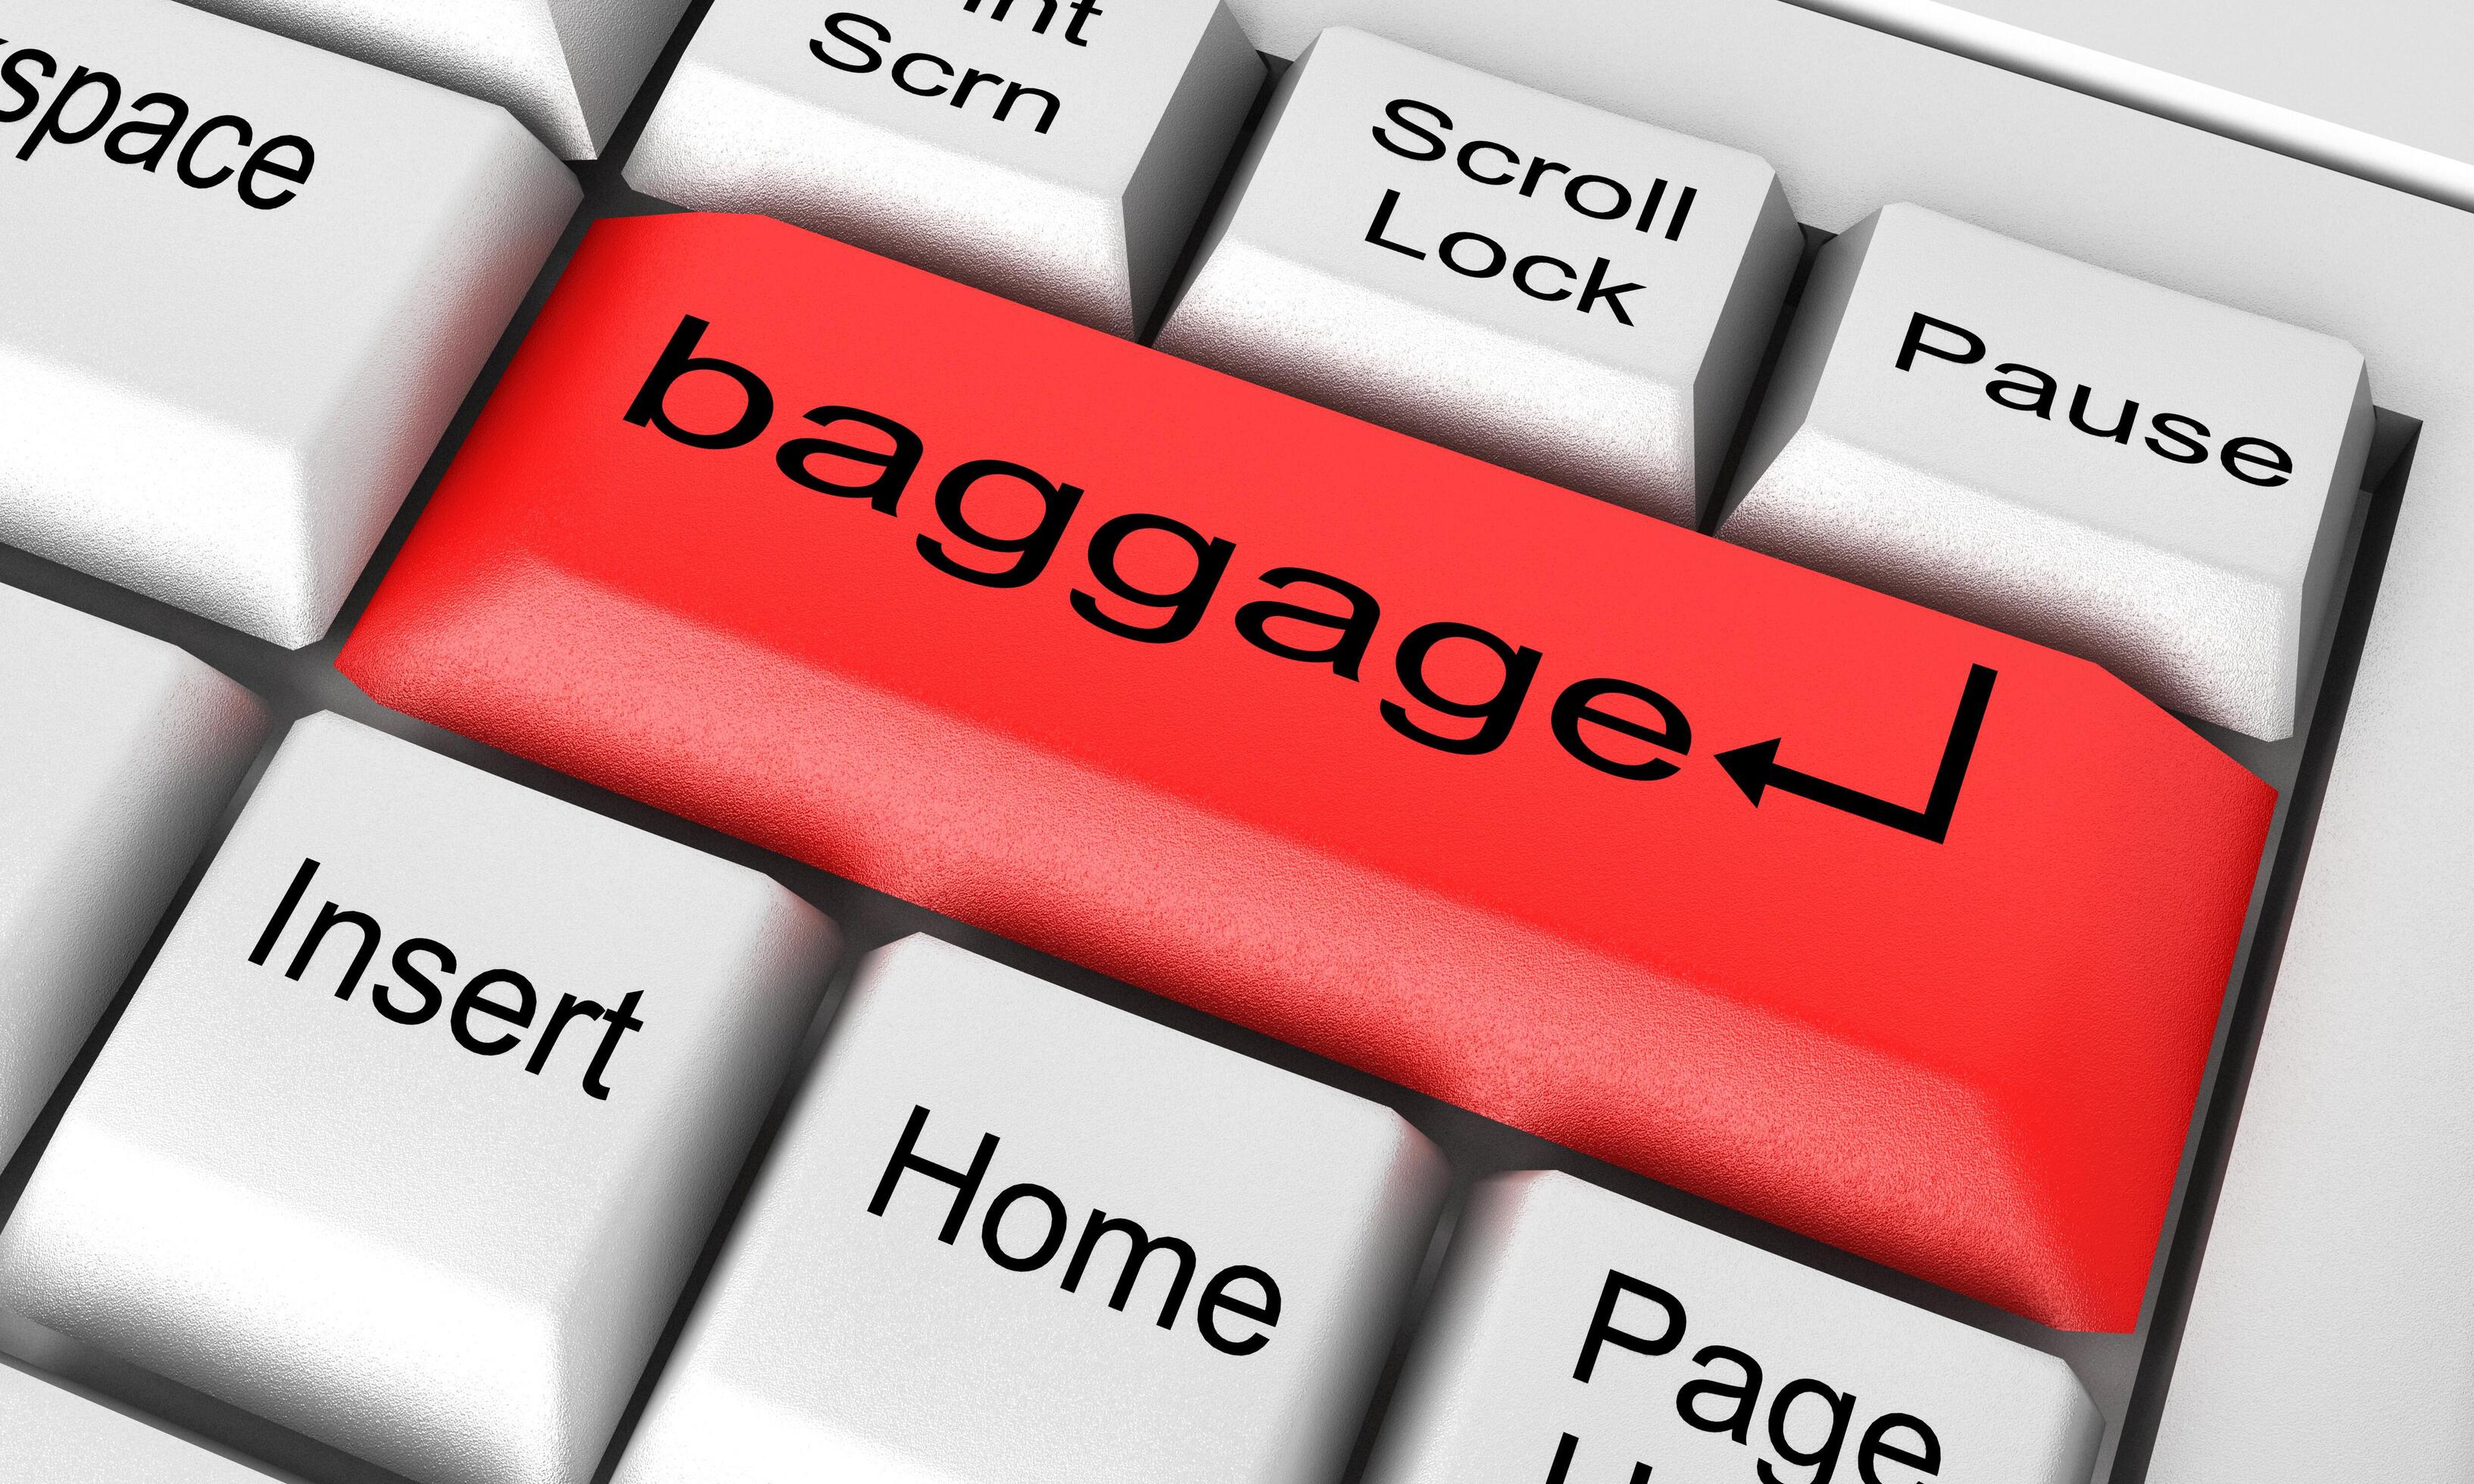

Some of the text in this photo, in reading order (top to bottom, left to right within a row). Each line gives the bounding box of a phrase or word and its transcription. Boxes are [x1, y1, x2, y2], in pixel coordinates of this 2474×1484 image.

[0, 38, 315, 210] space
[810, 12, 1060, 135] Scrn
[1365, 189, 1647, 327] Lock
[1372, 98, 1698, 242] Scroll
[1895, 311, 2293, 488] Pause
[623, 314, 1692, 781] baggage
[248, 857, 644, 1101] Insert
[866, 1104, 1281, 1356] Home
[1572, 1269, 1941, 1484] Page
